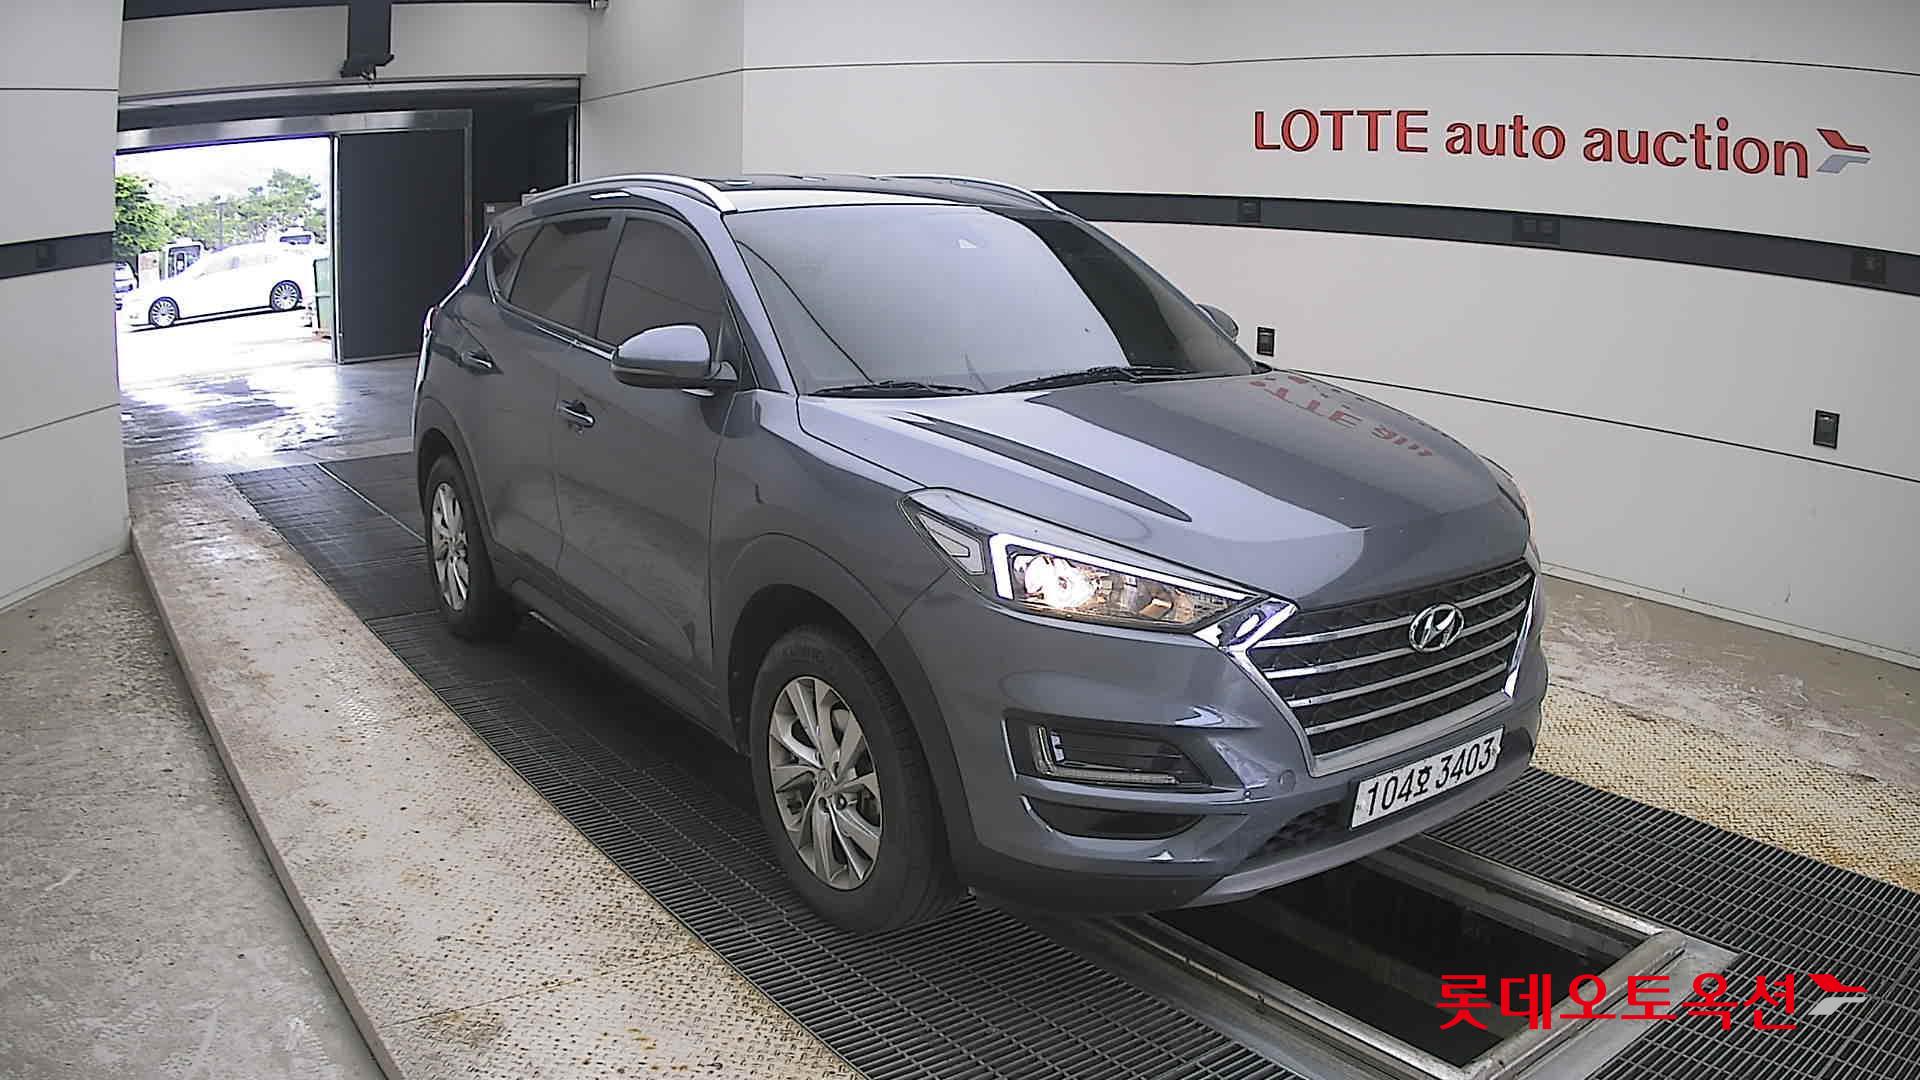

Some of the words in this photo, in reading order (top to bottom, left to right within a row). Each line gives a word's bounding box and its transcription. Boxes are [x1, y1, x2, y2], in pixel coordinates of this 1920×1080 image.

[1254, 110, 1428, 153] LOTTE
[1445, 115, 1566, 160] auto
[1583, 117, 1809, 178] auction
[1436, 737, 1495, 789] 3403
